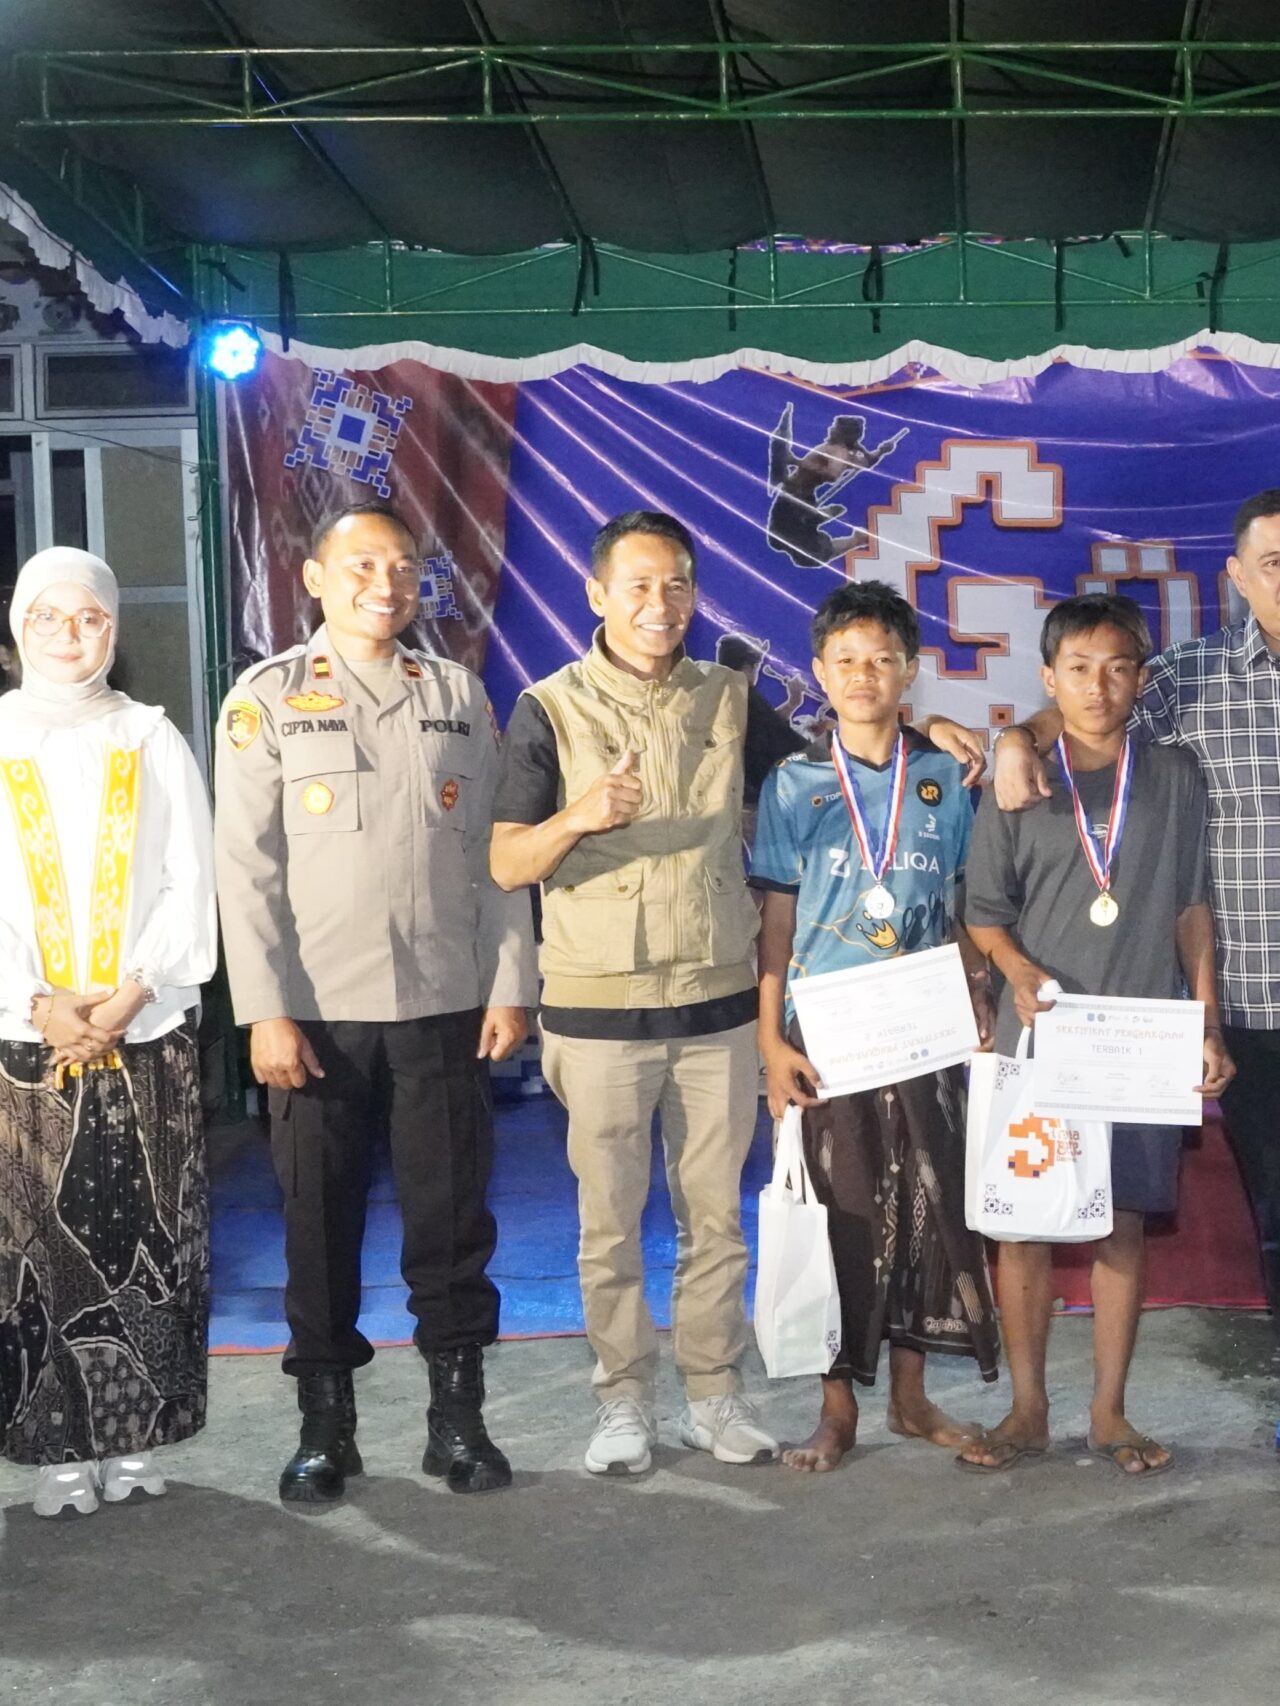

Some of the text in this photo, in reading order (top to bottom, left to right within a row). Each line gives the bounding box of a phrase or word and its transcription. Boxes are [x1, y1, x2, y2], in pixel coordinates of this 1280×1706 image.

[281, 719, 349, 737] CIPTA NAYA
[418, 719, 471, 737] POLRI
[1091, 1044, 1132, 1055] TERBAIK
